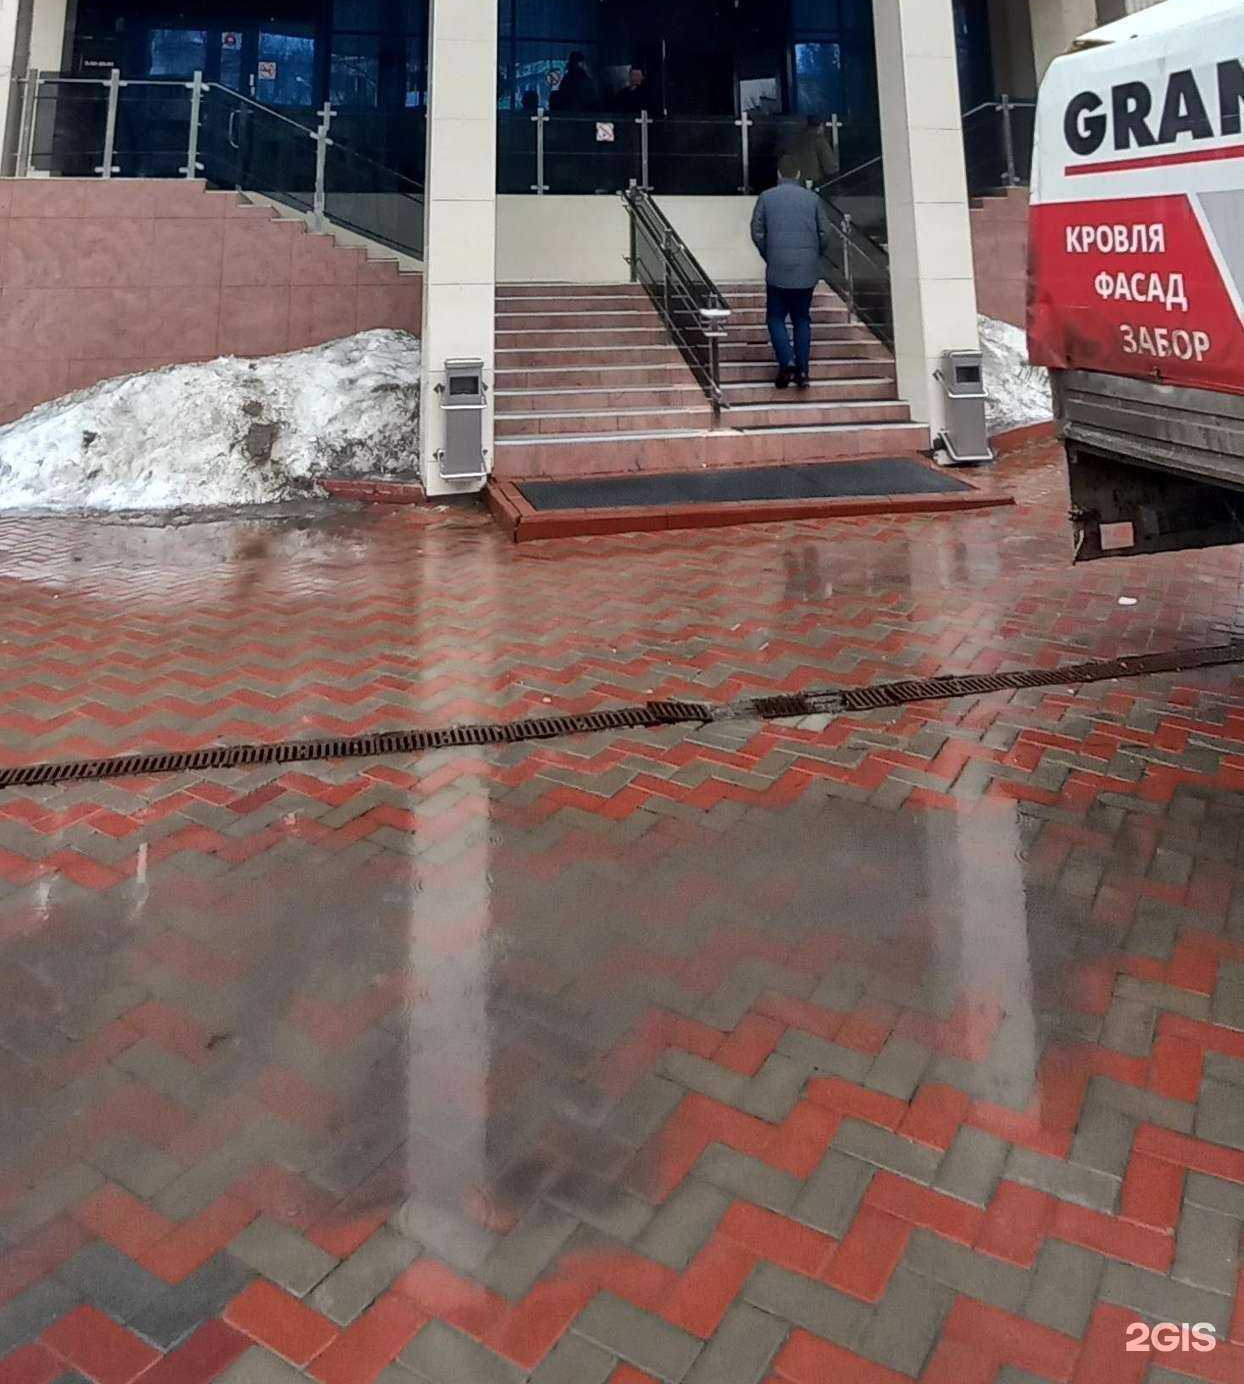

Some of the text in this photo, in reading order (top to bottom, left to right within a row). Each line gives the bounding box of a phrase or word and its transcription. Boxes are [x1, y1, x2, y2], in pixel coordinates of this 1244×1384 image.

[1065, 223, 1166, 254] КРОВЛЯ
[1094, 271, 1189, 312] ФАСАД
[1118, 324, 1211, 362] ЗАБОР
